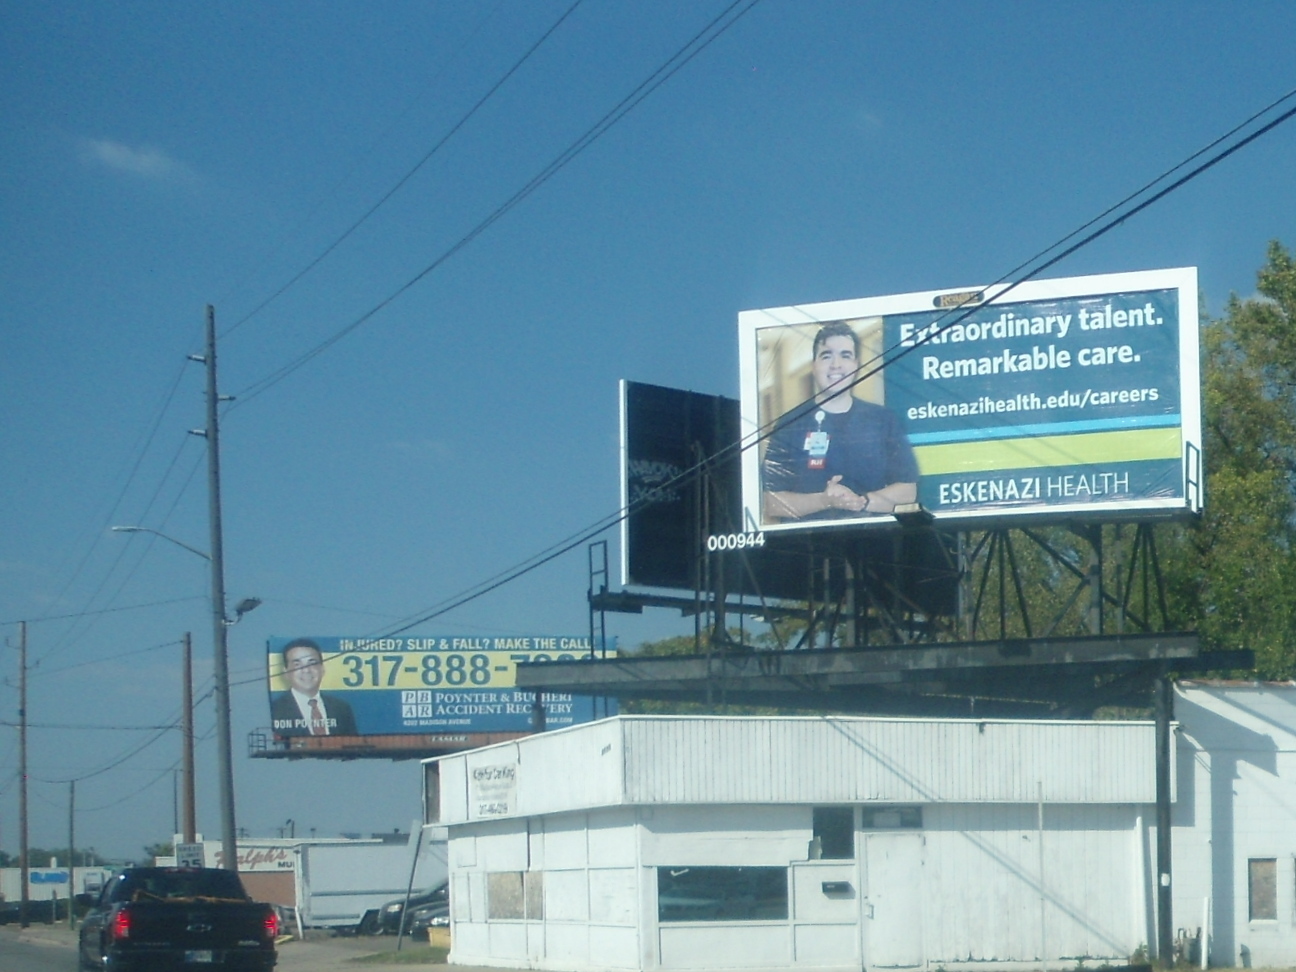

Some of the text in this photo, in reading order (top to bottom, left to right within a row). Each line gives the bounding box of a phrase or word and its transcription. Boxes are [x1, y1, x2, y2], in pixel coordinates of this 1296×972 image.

[899, 302, 1164, 348] Extraordinary talent.
[922, 342, 1141, 380] Remarkable care.
[907, 386, 1159, 420] eskenazihealth.edu/careers
[938, 472, 1130, 505] ESKENAZI HEALTH
[707, 532, 766, 551] 000944
[407, 639, 435, 650] SLIP
[439, 639, 449, 650] &
[453, 638, 490, 650] FALL?
[494, 638, 530, 649] MAKE
[533, 638, 557, 649] THE
[342, 654, 599, 687] 317-888-
[435, 692, 498, 703] POYNTER
[500, 692, 510, 702] &
[435, 704, 503, 715] ACCIDENT
[274, 718, 293, 729] DON
